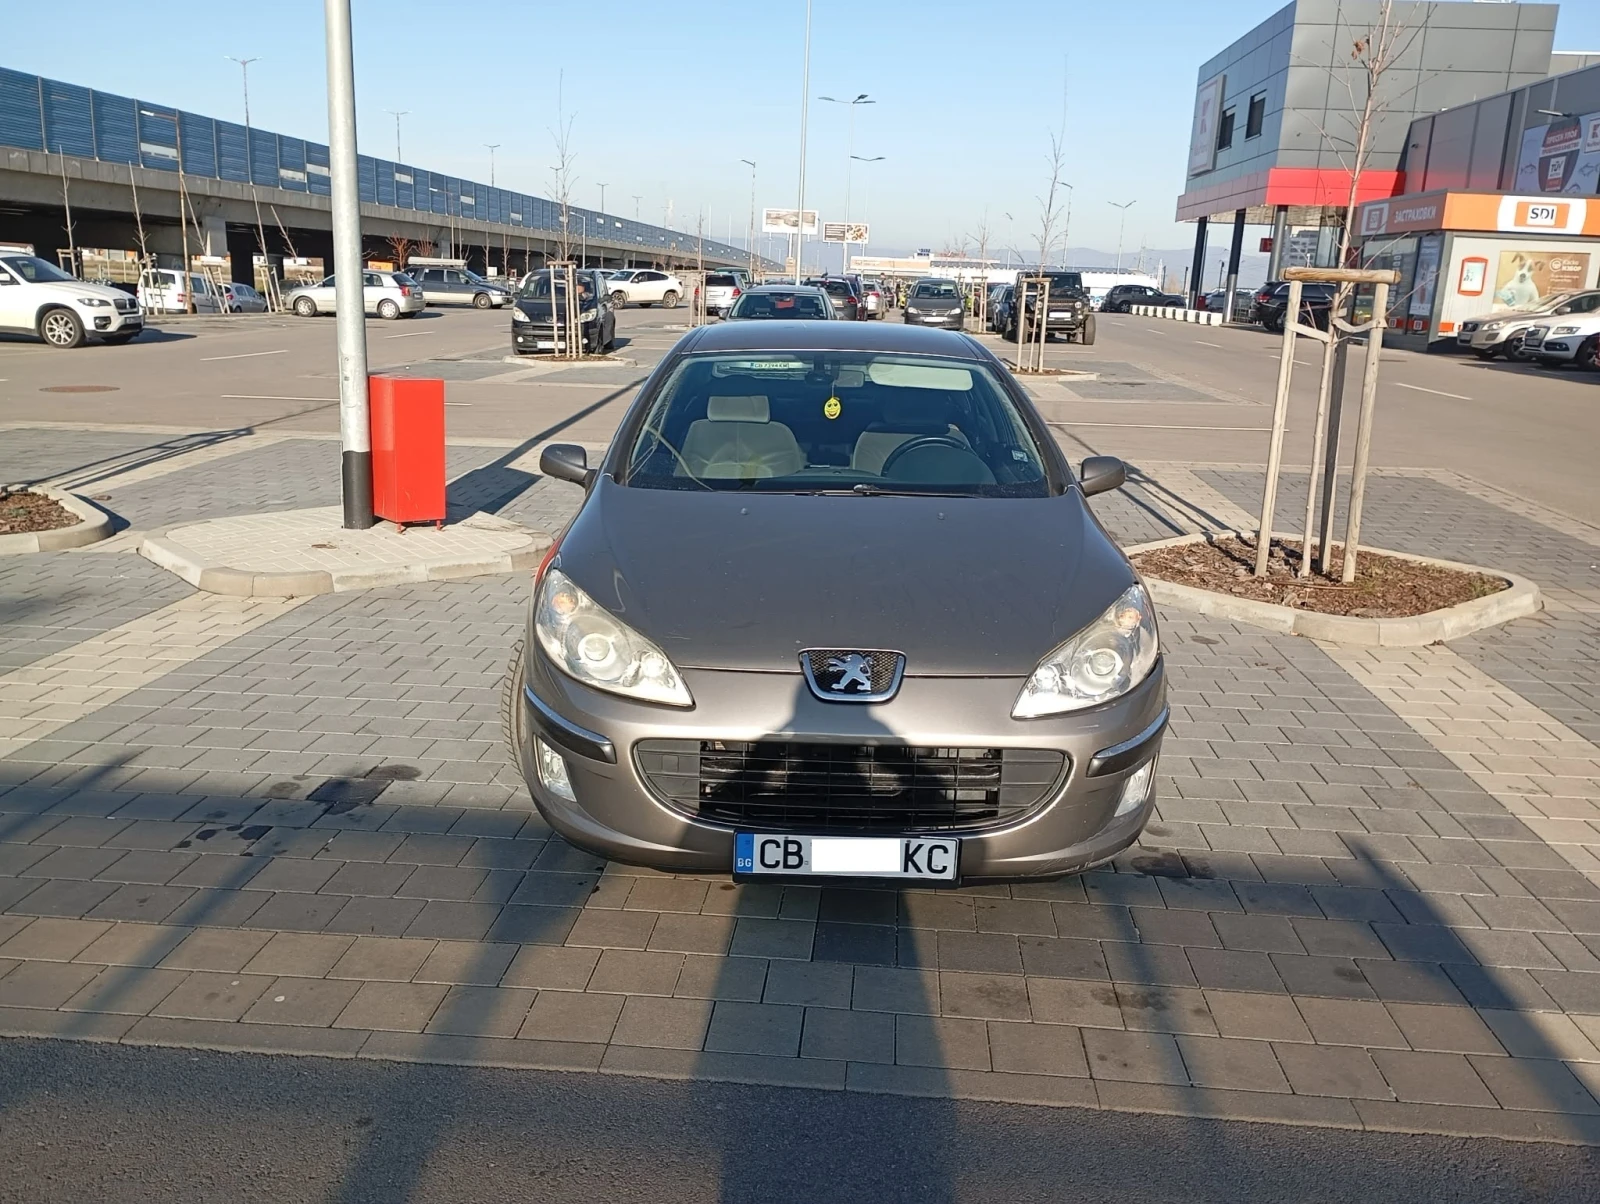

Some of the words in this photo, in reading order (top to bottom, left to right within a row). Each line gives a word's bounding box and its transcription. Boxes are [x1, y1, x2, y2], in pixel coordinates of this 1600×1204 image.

[1394, 205, 1437, 223] ЗАСТРАХОВКИ
[1530, 207, 1555, 220] SDI
[737, 857, 752, 868] BG
[760, 839, 804, 870] CB
[903, 842, 949, 874] KC
